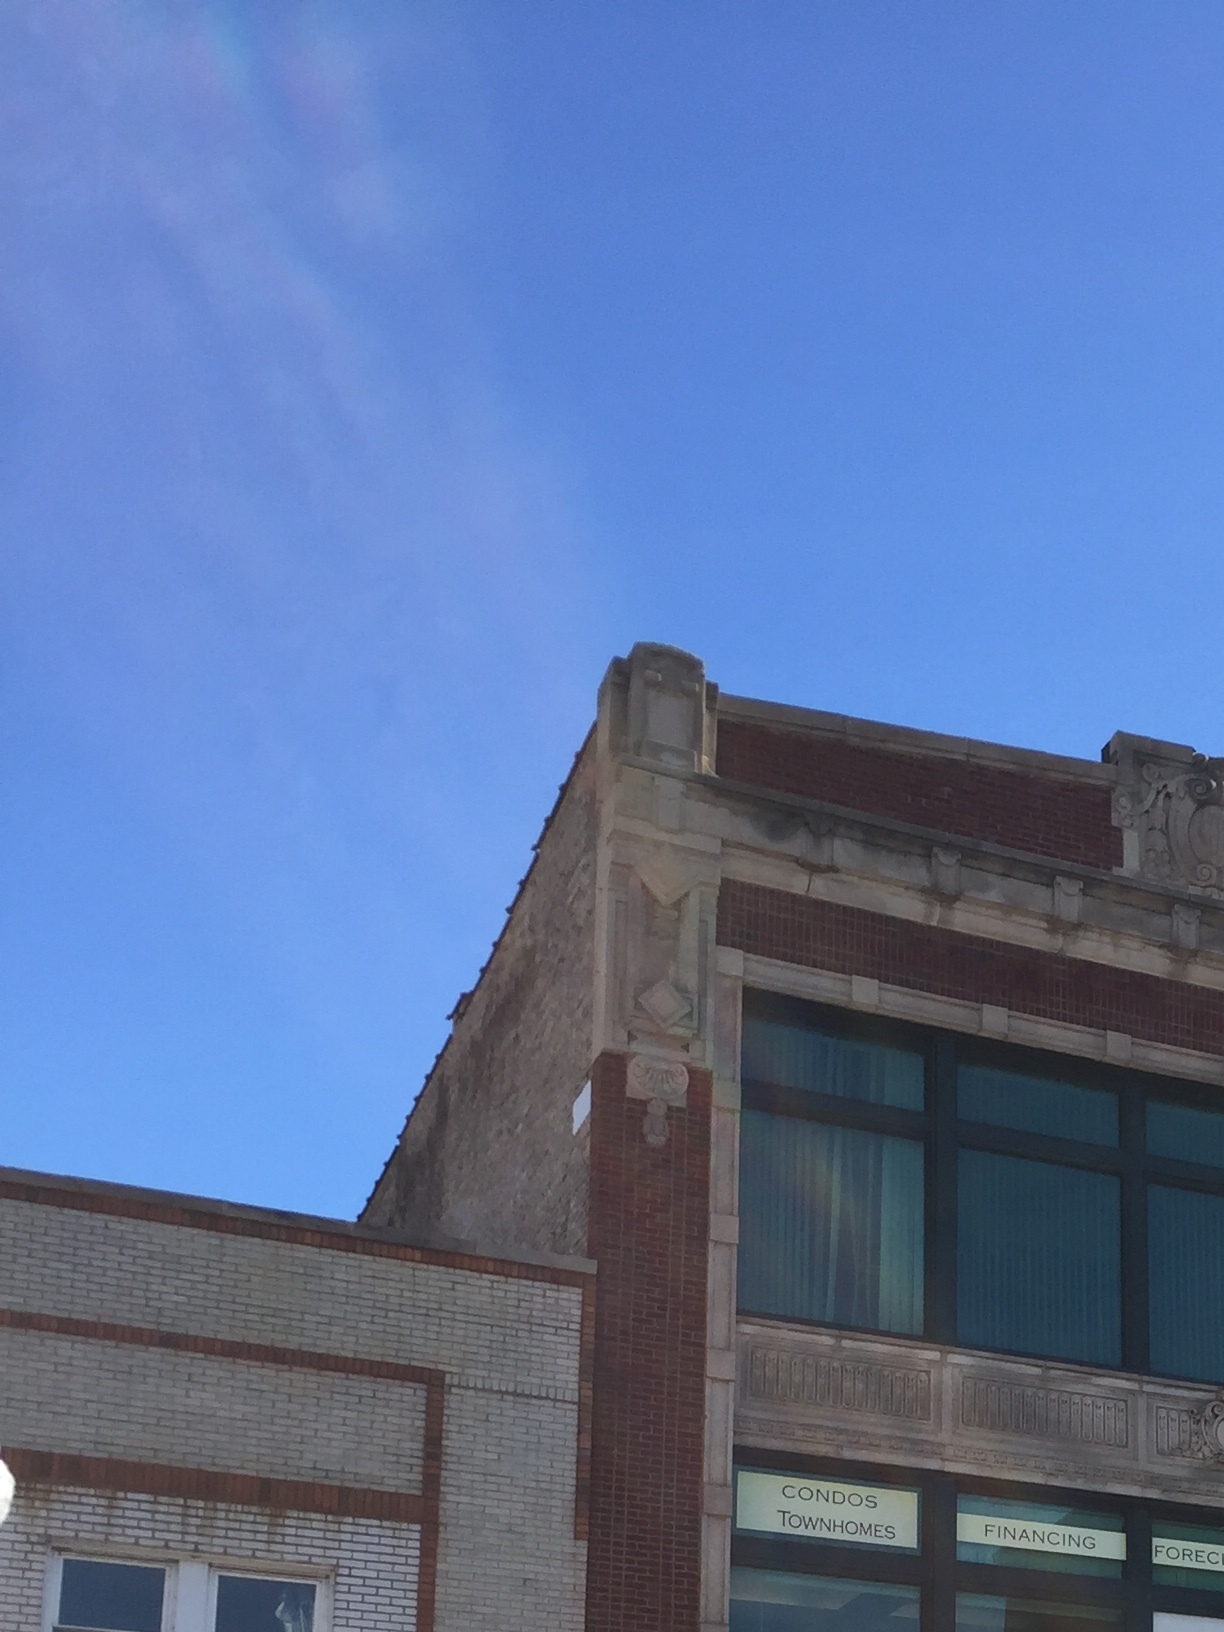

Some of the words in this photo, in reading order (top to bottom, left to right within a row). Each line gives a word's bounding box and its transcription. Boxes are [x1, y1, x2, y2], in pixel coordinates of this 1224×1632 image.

[781, 1484, 878, 1509] CONDOS
[777, 1510, 896, 1540] TOWNHOMES
[984, 1524, 1097, 1550] FINANCING
